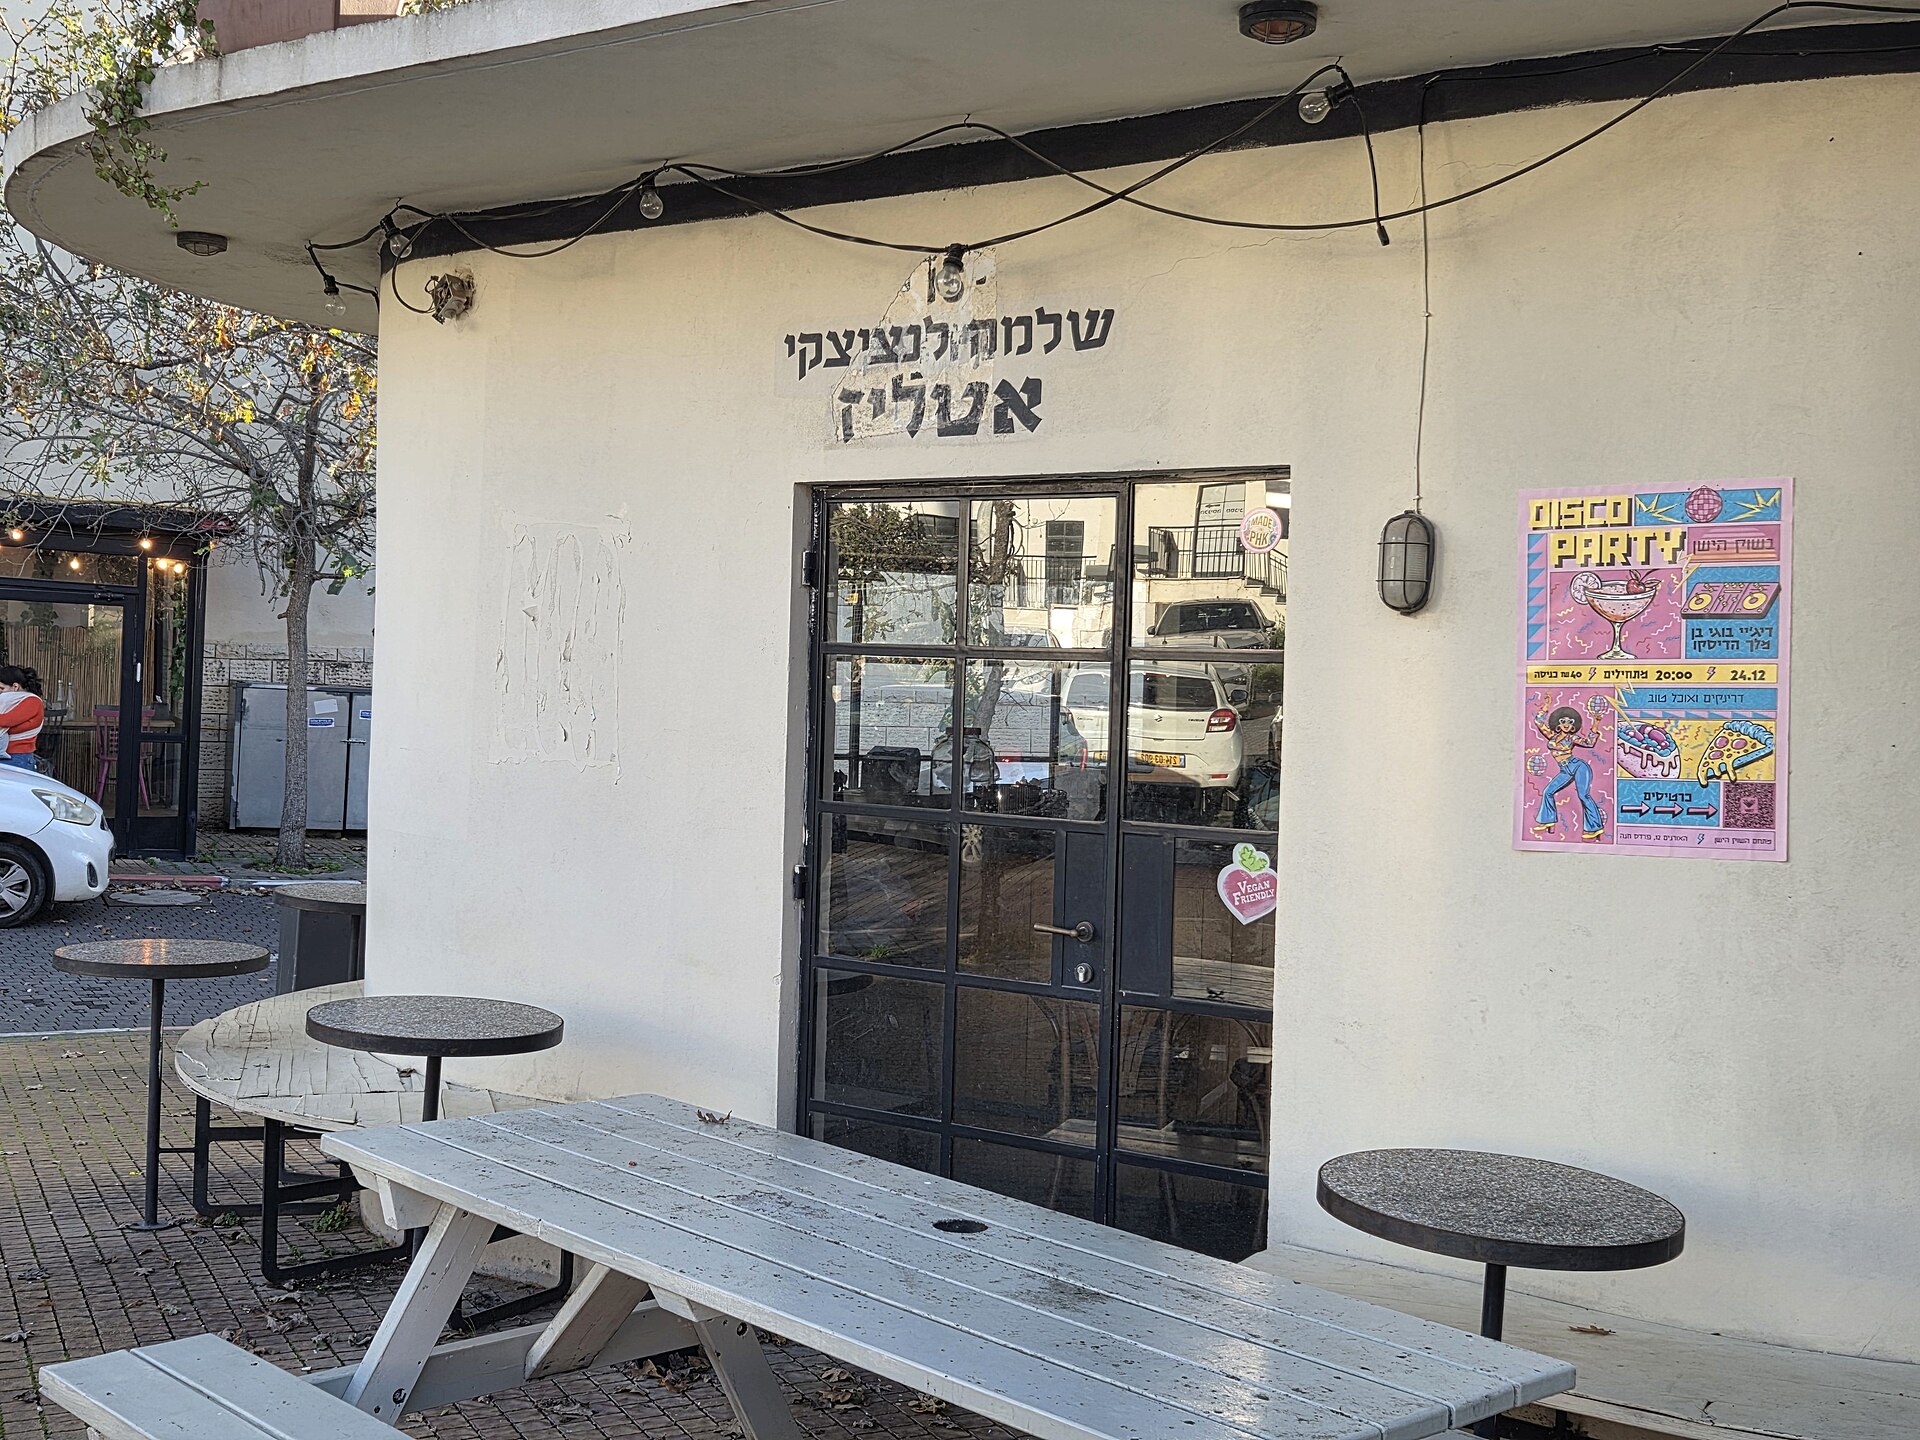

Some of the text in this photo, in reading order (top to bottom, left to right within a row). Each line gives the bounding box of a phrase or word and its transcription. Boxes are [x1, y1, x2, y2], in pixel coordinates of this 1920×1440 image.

[837, 371, 1043, 443] אטליז
[1529, 496, 1632, 530] DISCO
[1251, 515, 1273, 529] MADE
[1250, 531, 1269, 546] PHK
[1551, 527, 1687, 568] PARTY
[1693, 538, 1775, 555] בשוק הישן
[1691, 628, 1704, 640] בן
[1708, 627, 1734, 638] בוגי
[1693, 638, 1770, 652] מלך הדיסקו
[1603, 669, 1648, 679] מתחילים
[1655, 669, 1693, 681] 20:00
[1730, 669, 1766, 681] 24.12
[1647, 693, 1744, 705] דרינקים ואוכל טוב
[1643, 791, 1692, 802] כרטיסים
[1237, 880, 1270, 894] VEGAN
[1232, 888, 1275, 906] FRIENDLY
